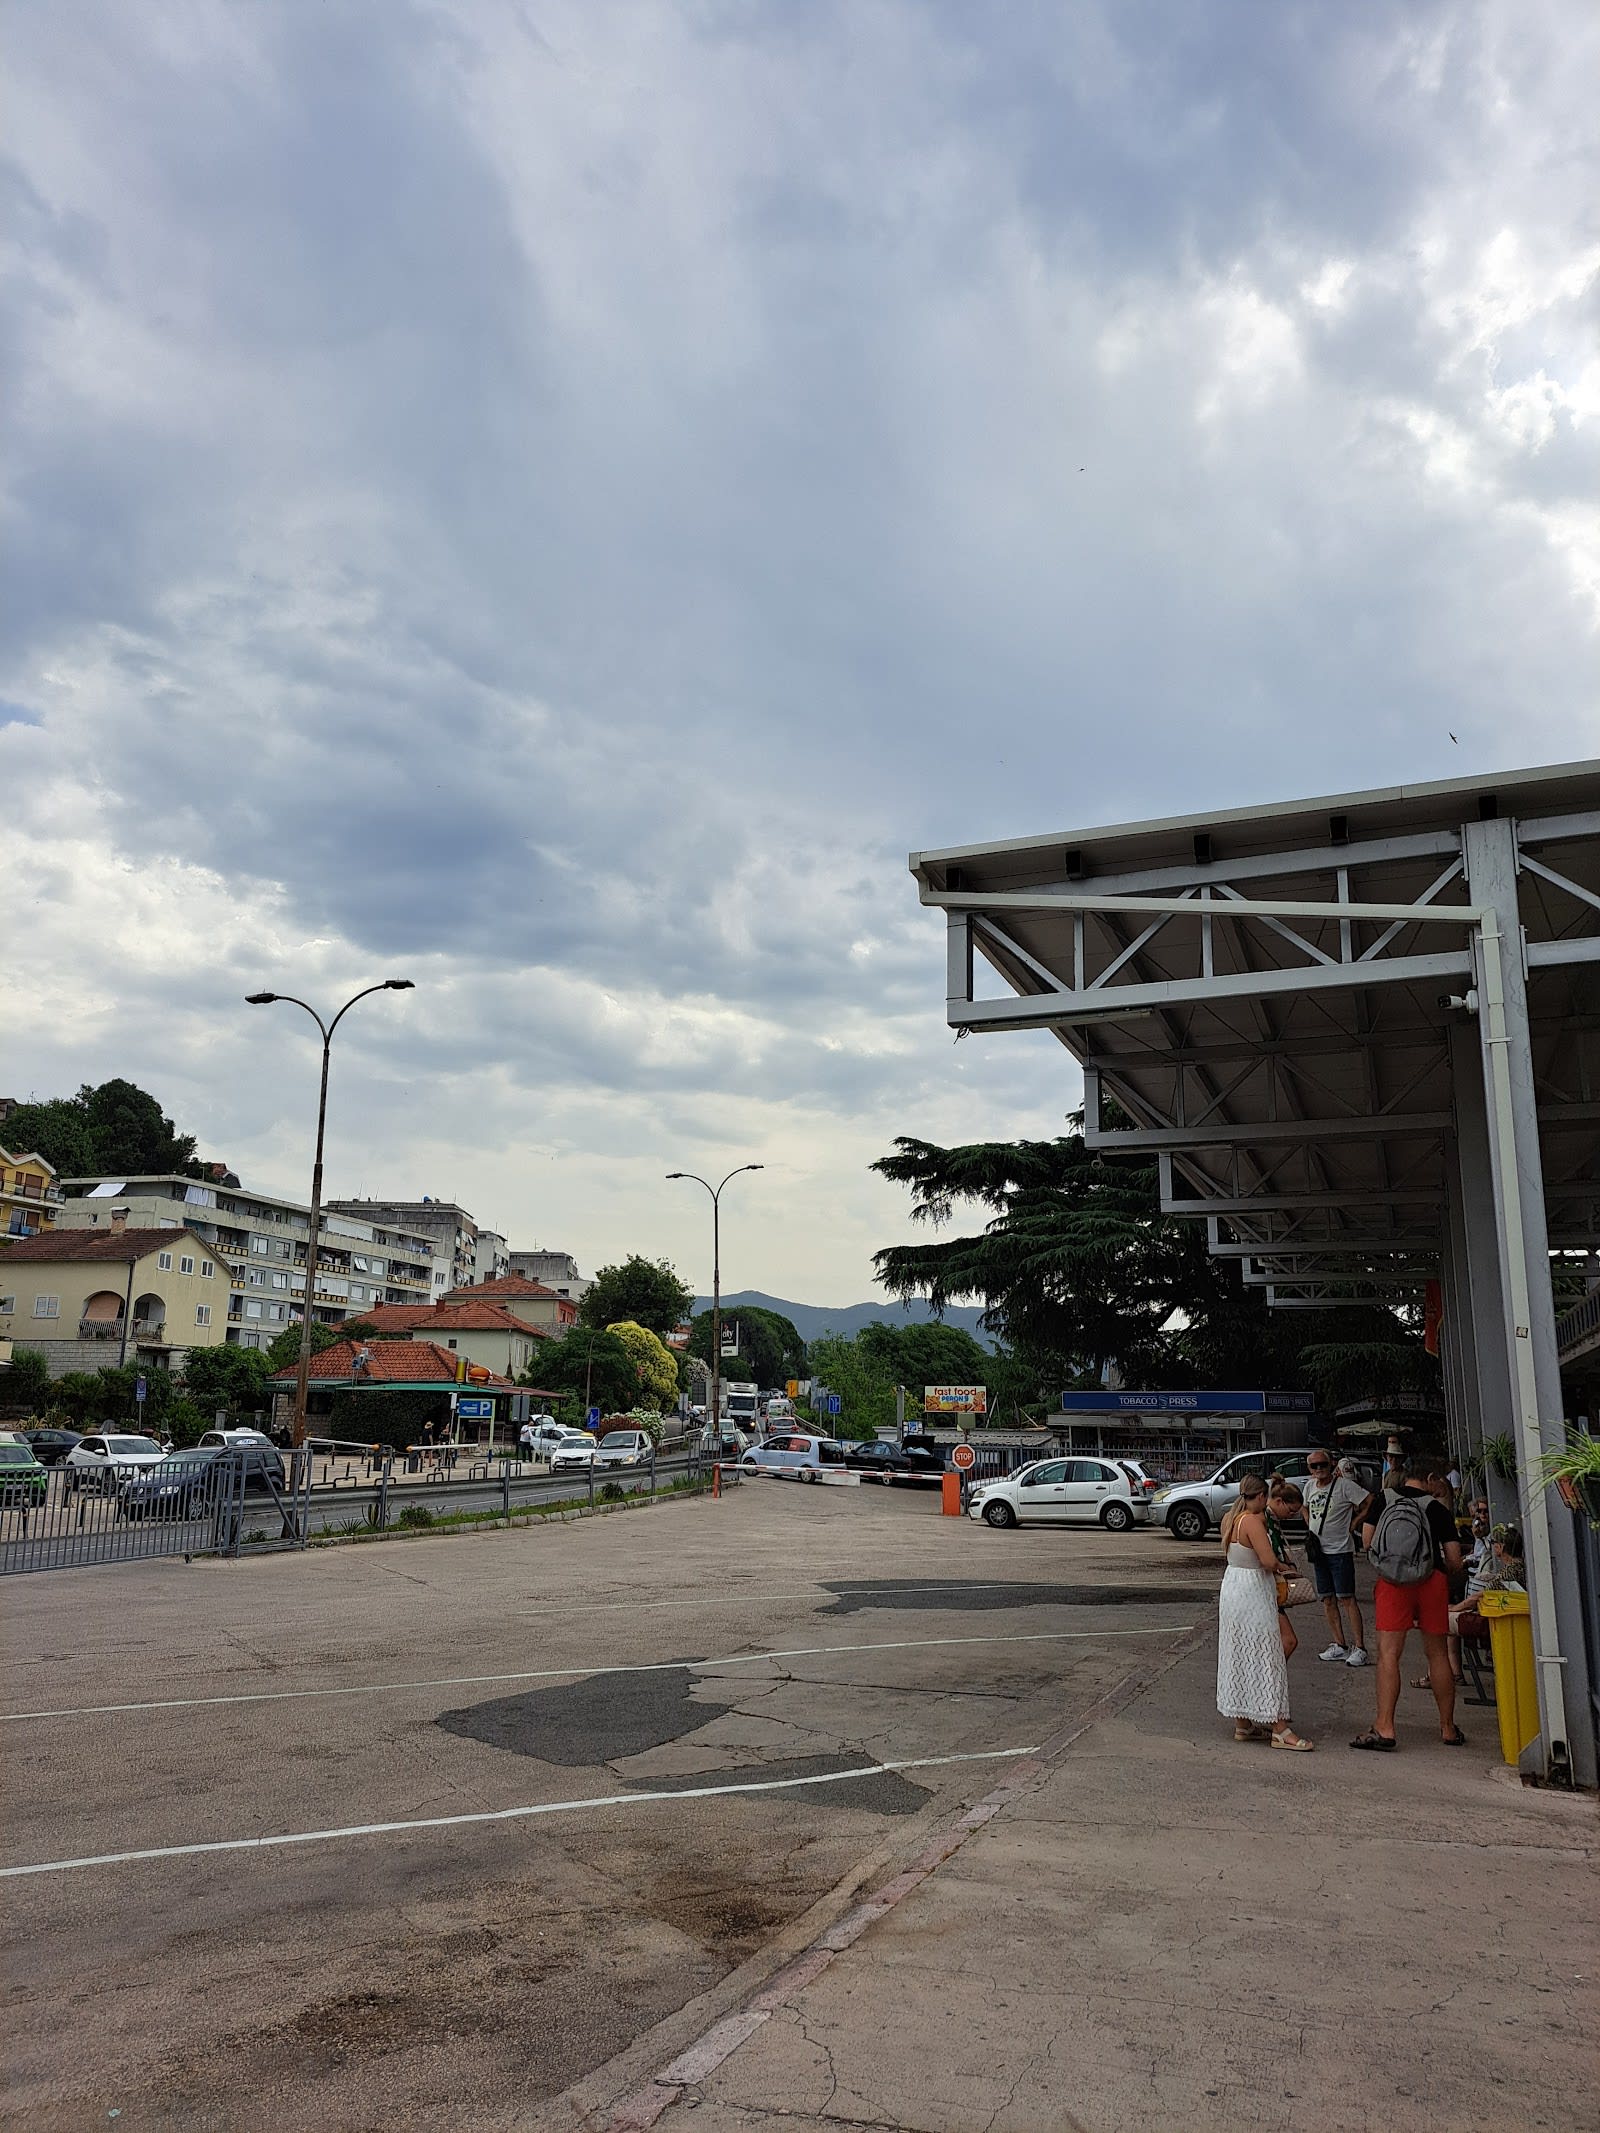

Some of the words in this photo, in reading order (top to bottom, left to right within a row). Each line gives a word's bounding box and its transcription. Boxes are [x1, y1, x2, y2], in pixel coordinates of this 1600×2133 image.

[934, 1388, 951, 1396] fast
[954, 1388, 976, 1396] food
[1119, 1397, 1158, 1405] TOBACCO
[1169, 1397, 1198, 1406] PRESS
[479, 1401, 491, 1416] P
[955, 1452, 972, 1461] STOP
